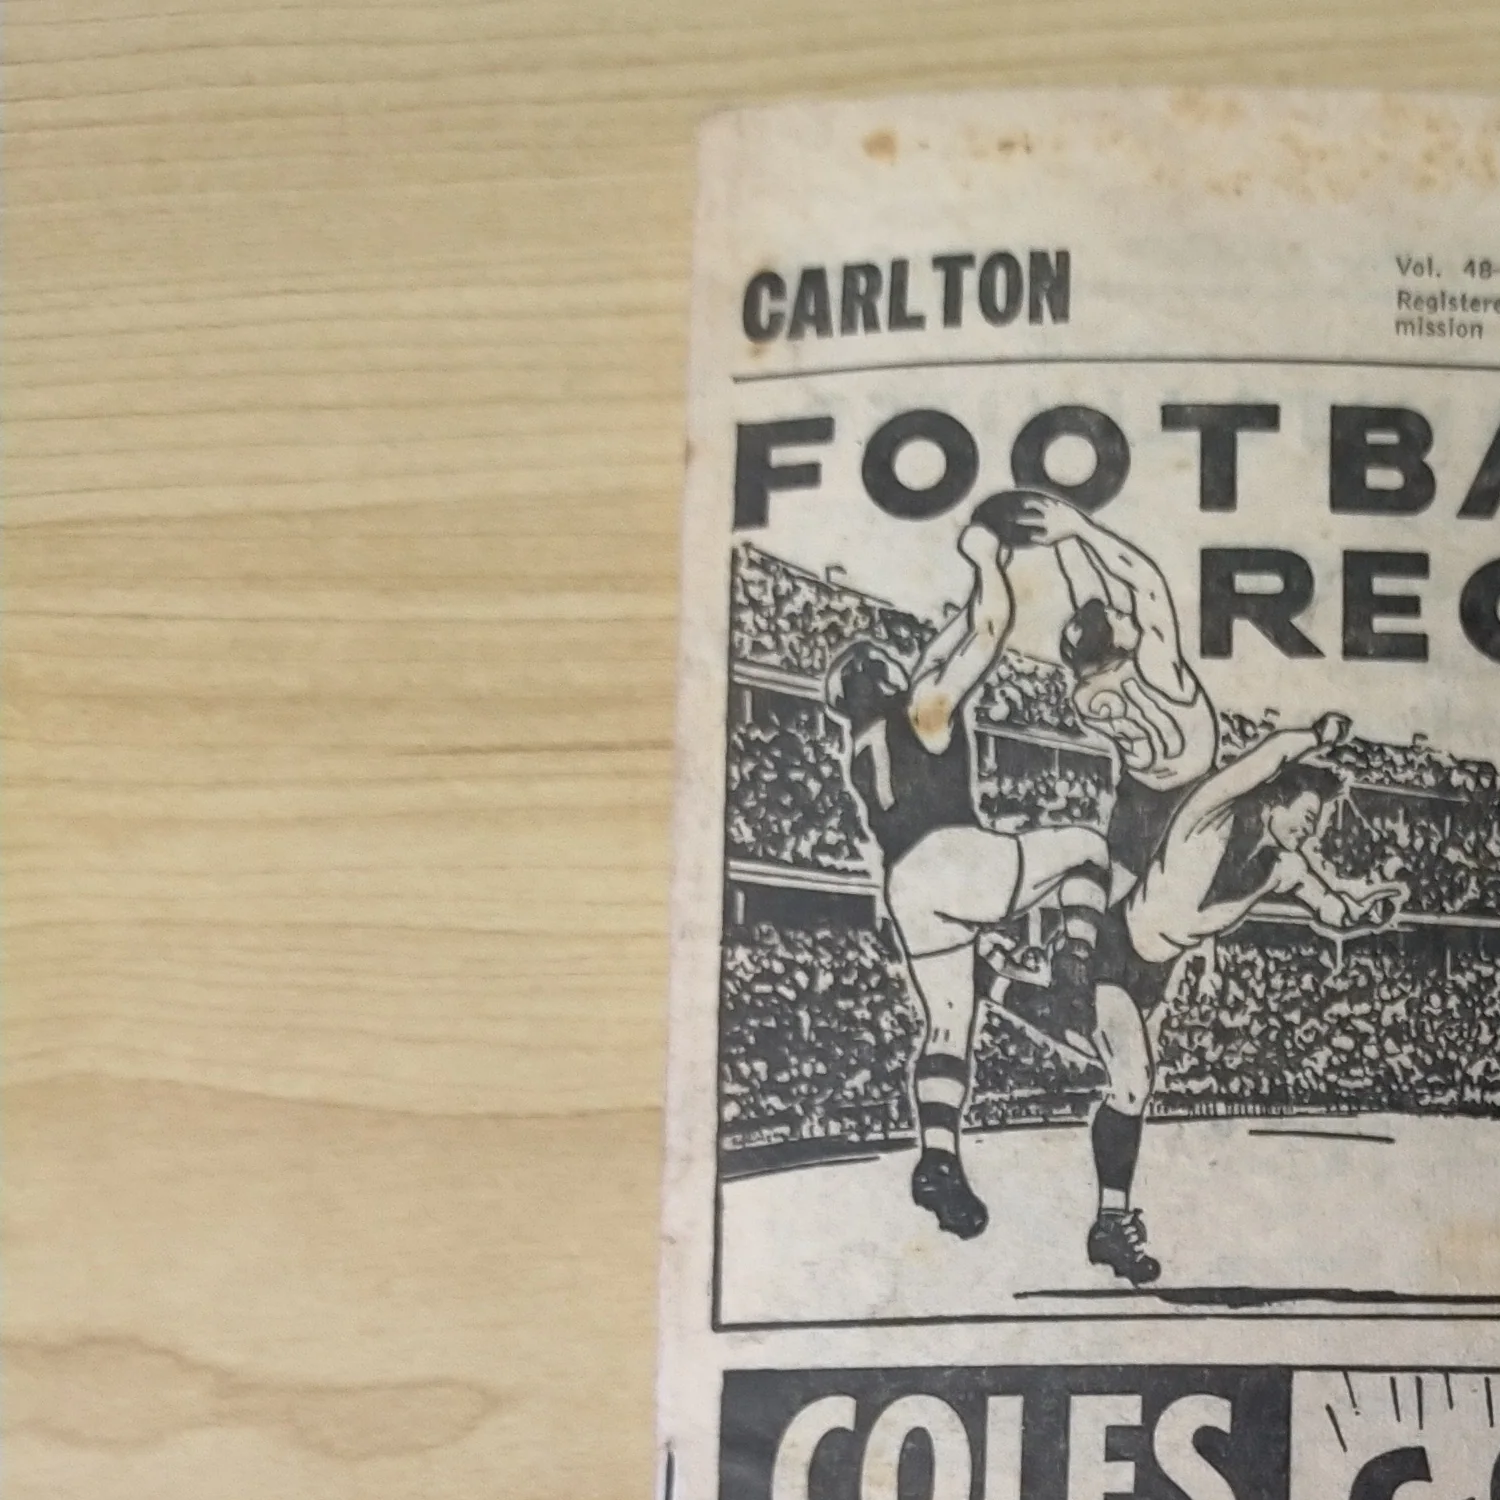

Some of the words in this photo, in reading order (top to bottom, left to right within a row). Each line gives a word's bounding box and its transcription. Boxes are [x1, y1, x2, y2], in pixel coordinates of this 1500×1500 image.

[1395, 257, 1441, 279] Vol.
[742, 250, 1070, 343] CARLTON
[1395, 317, 1483, 340] mission
